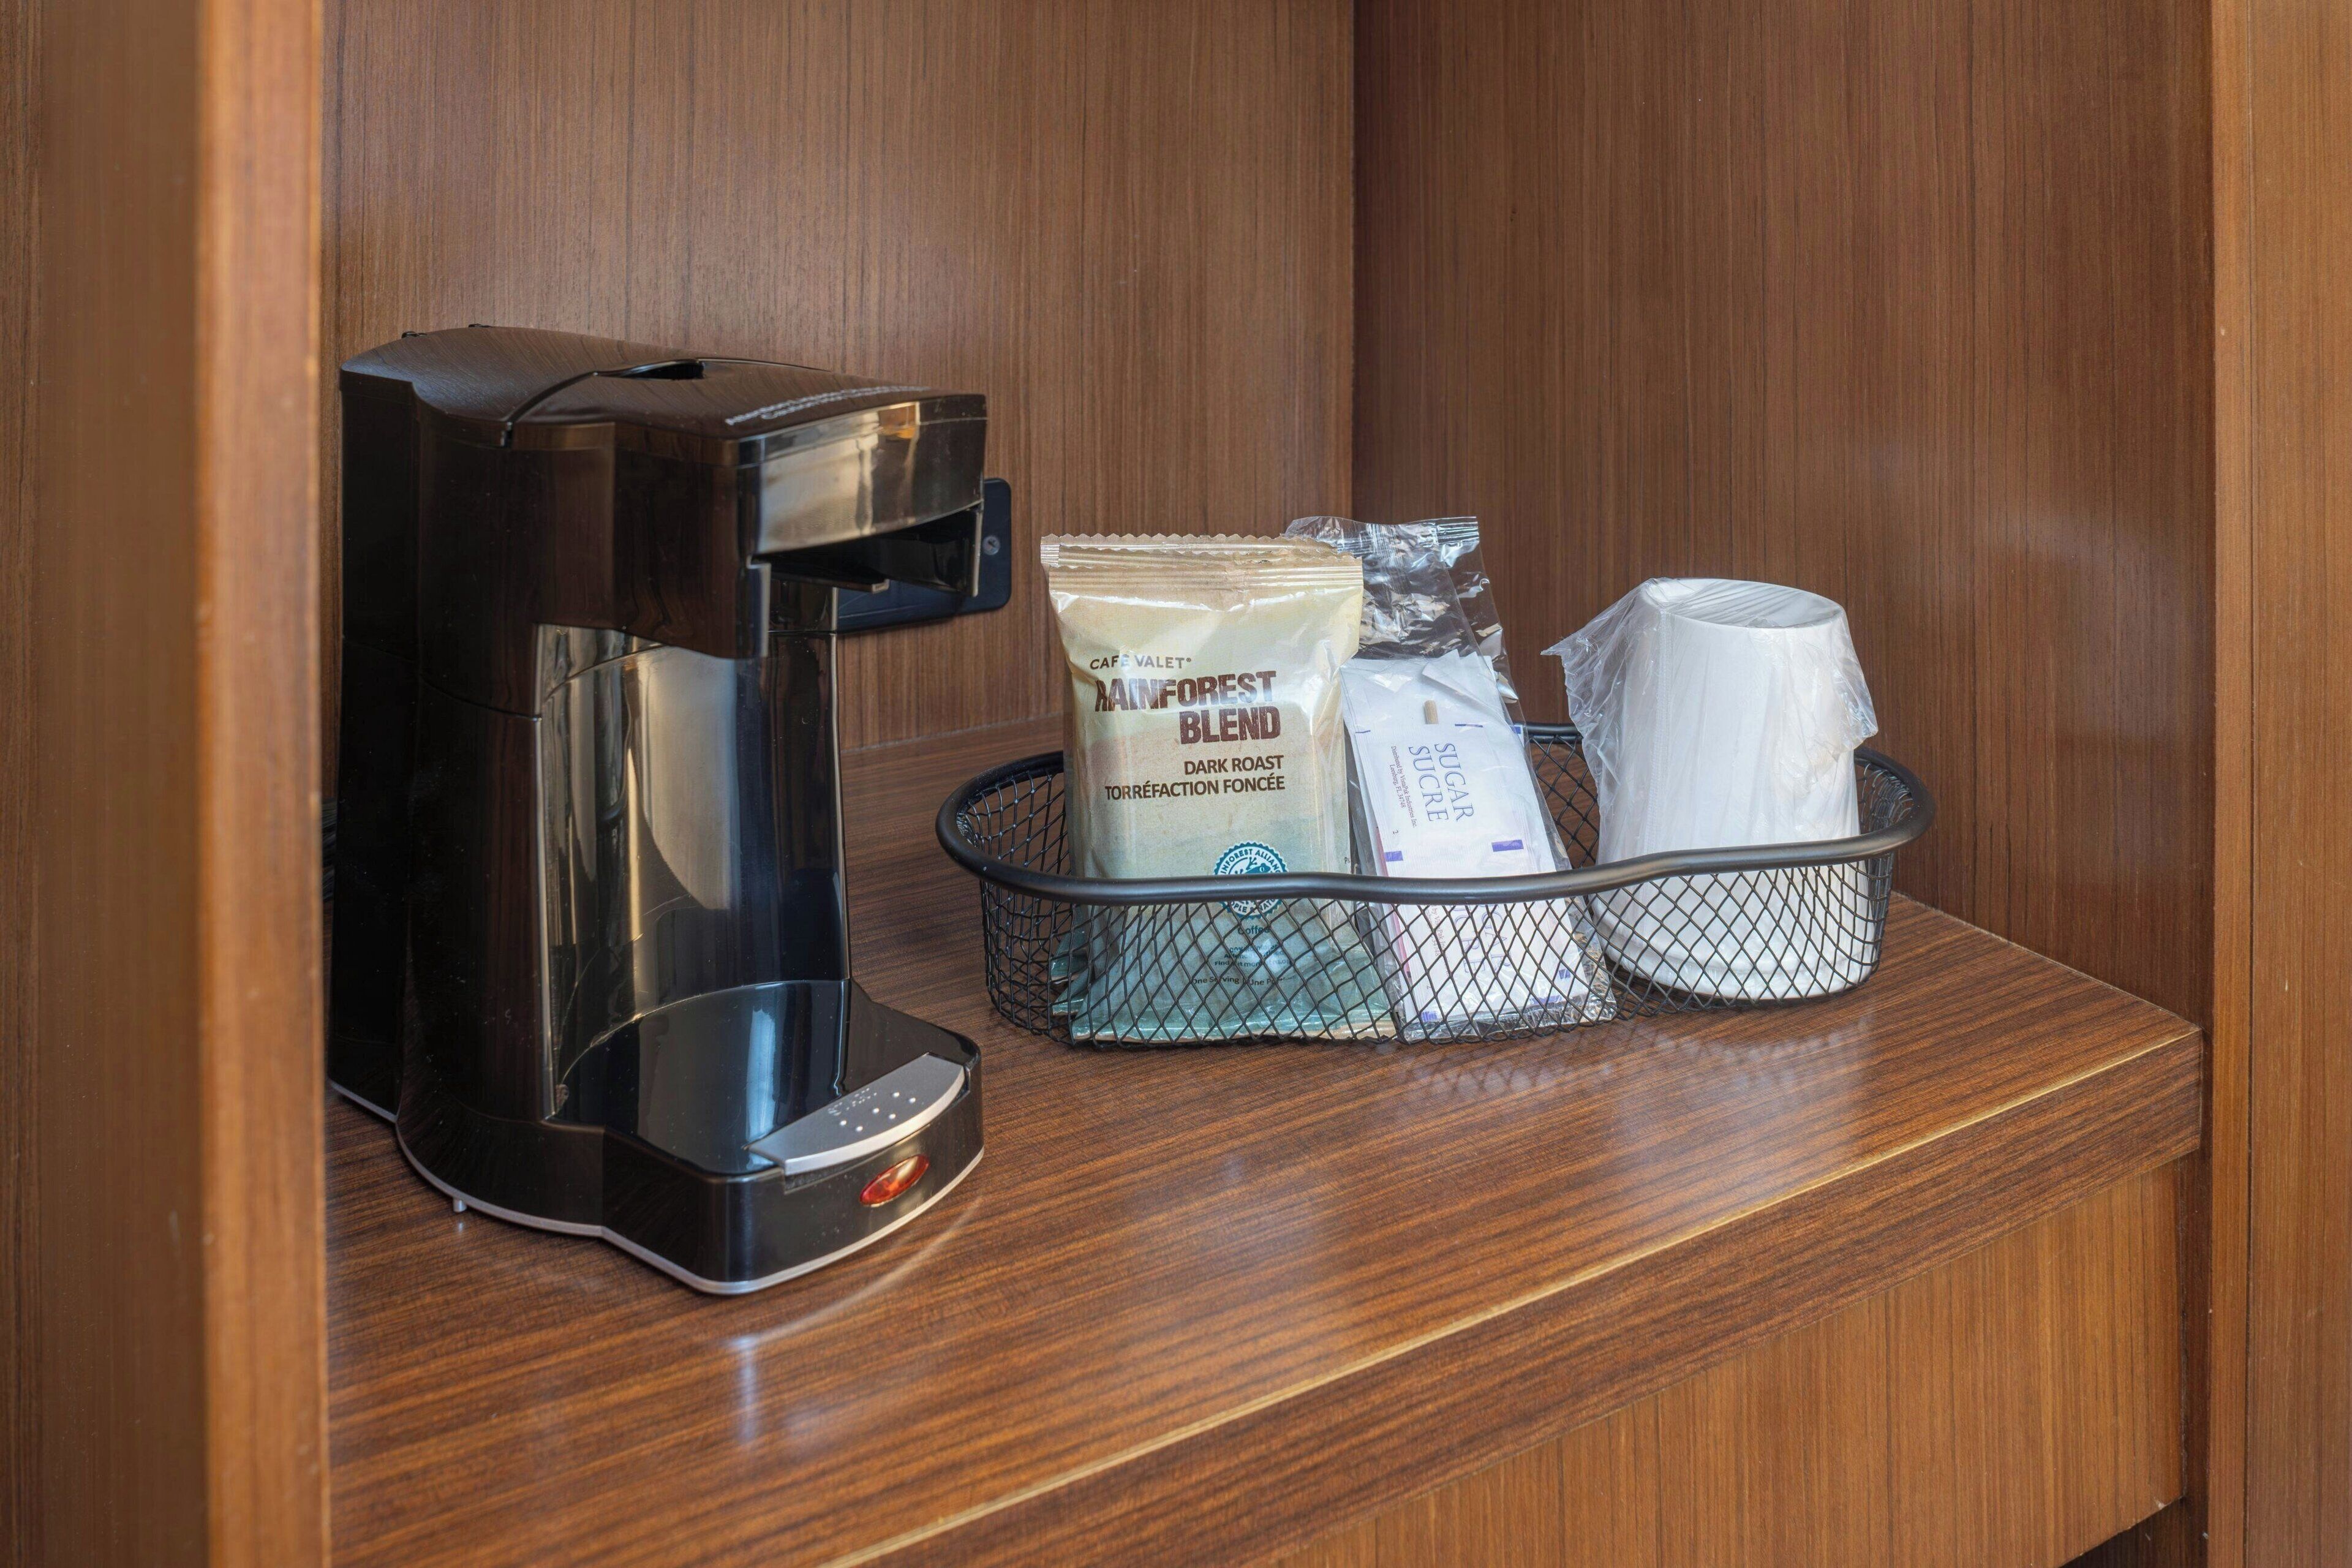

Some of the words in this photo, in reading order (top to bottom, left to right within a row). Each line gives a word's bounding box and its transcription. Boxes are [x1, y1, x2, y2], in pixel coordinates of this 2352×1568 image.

[1095, 671, 1276, 712] RAINFOREST
[1179, 706, 1281, 745] BLEND
[1184, 758, 1229, 775] DARK
[1232, 755, 1284, 772] ROAST
[1390, 745, 1403, 768] Distributed
[1404, 795, 1414, 818] Industries
[1409, 745, 1449, 821] SUCRE
[1434, 742, 1474, 822] SUGAR
[1105, 780, 1219, 801] TORRÉFACTION
[1223, 772, 1286, 794] FONCÉE
[1209, 976, 1240, 985] Sving
